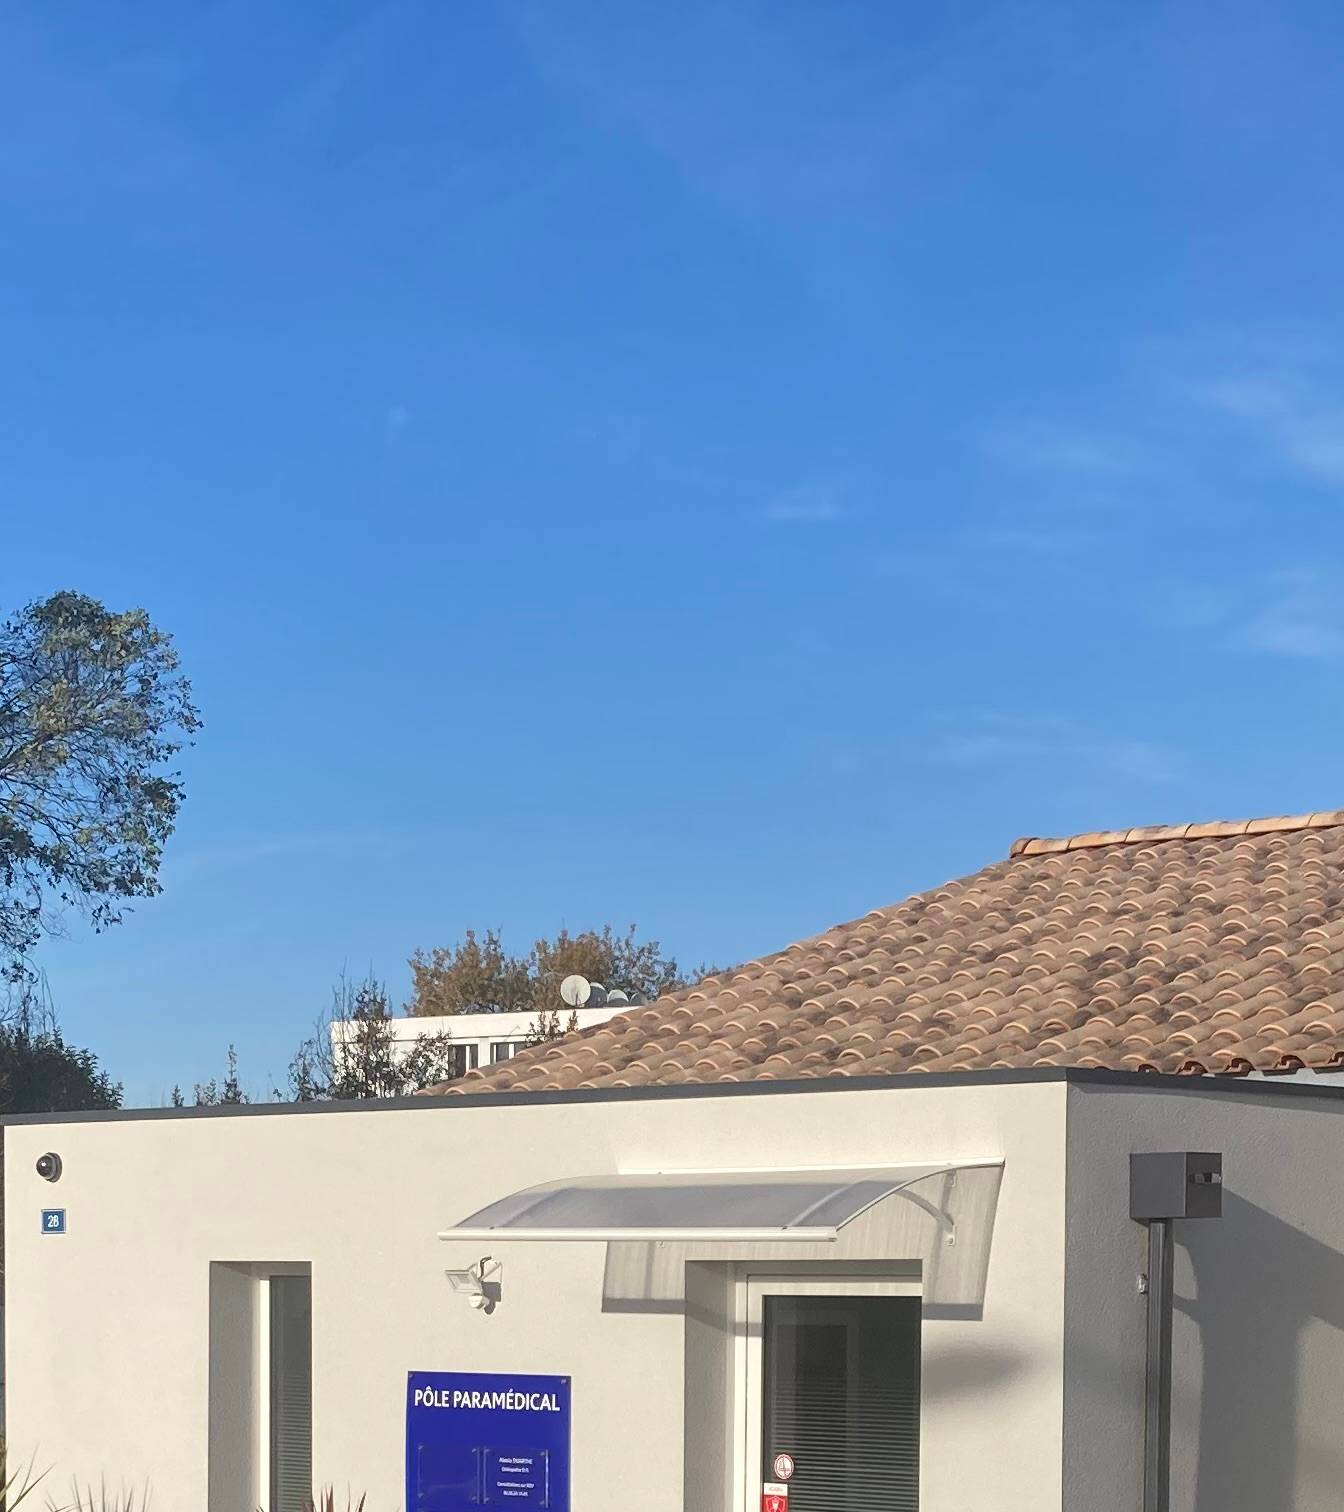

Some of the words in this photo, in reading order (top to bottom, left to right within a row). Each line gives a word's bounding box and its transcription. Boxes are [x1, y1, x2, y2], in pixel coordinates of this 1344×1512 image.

[47, 1214, 60, 1228] 28
[414, 1385, 450, 1408] PÔLE
[453, 1388, 561, 1412] PARAMÉDICAL
